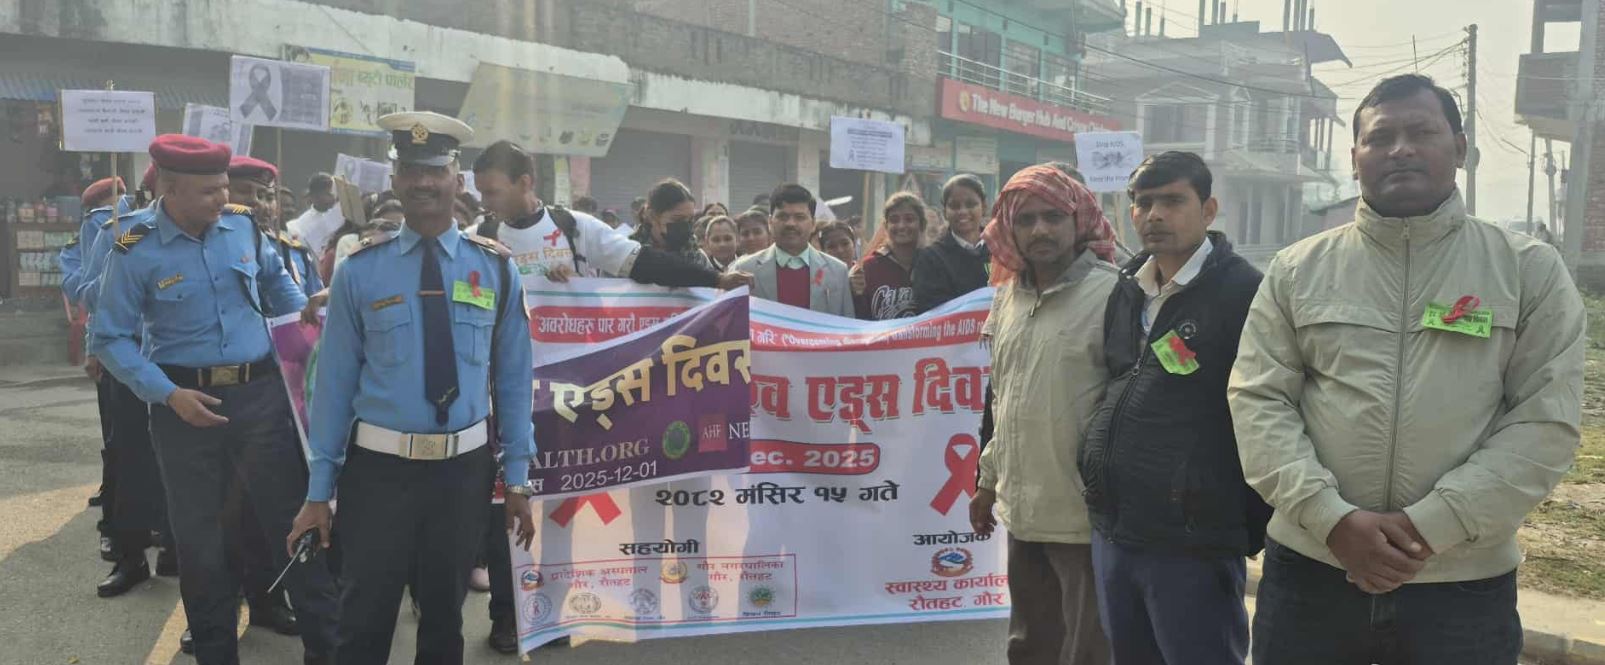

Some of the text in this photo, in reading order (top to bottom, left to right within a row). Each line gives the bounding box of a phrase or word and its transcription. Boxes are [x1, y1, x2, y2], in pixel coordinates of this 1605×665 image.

[972, 93, 988, 113] The
[989, 97, 1008, 118] New
[1009, 102, 1035, 127] Burger
[1036, 109, 1050, 127] Hub
[1052, 113, 1066, 131] And
[598, 318, 614, 334] पार
[943, 320, 956, 336] the
[958, 318, 976, 336] AIDS
[550, 357, 654, 431] एड्स
[805, 373, 903, 435] एड्स
[911, 357, 991, 416] दिव
[703, 424, 722, 440] AHF
[750, 449, 875, 468] ec. 2025
[560, 459, 658, 492] 2025-12-01
[655, 479, 900, 507] २०८२ मंसिर १५ गते
[619, 538, 700, 556] सहयोगी
[884, 578, 948, 595] स्वास्थ्य
[973, 589, 1005, 607] गौर
